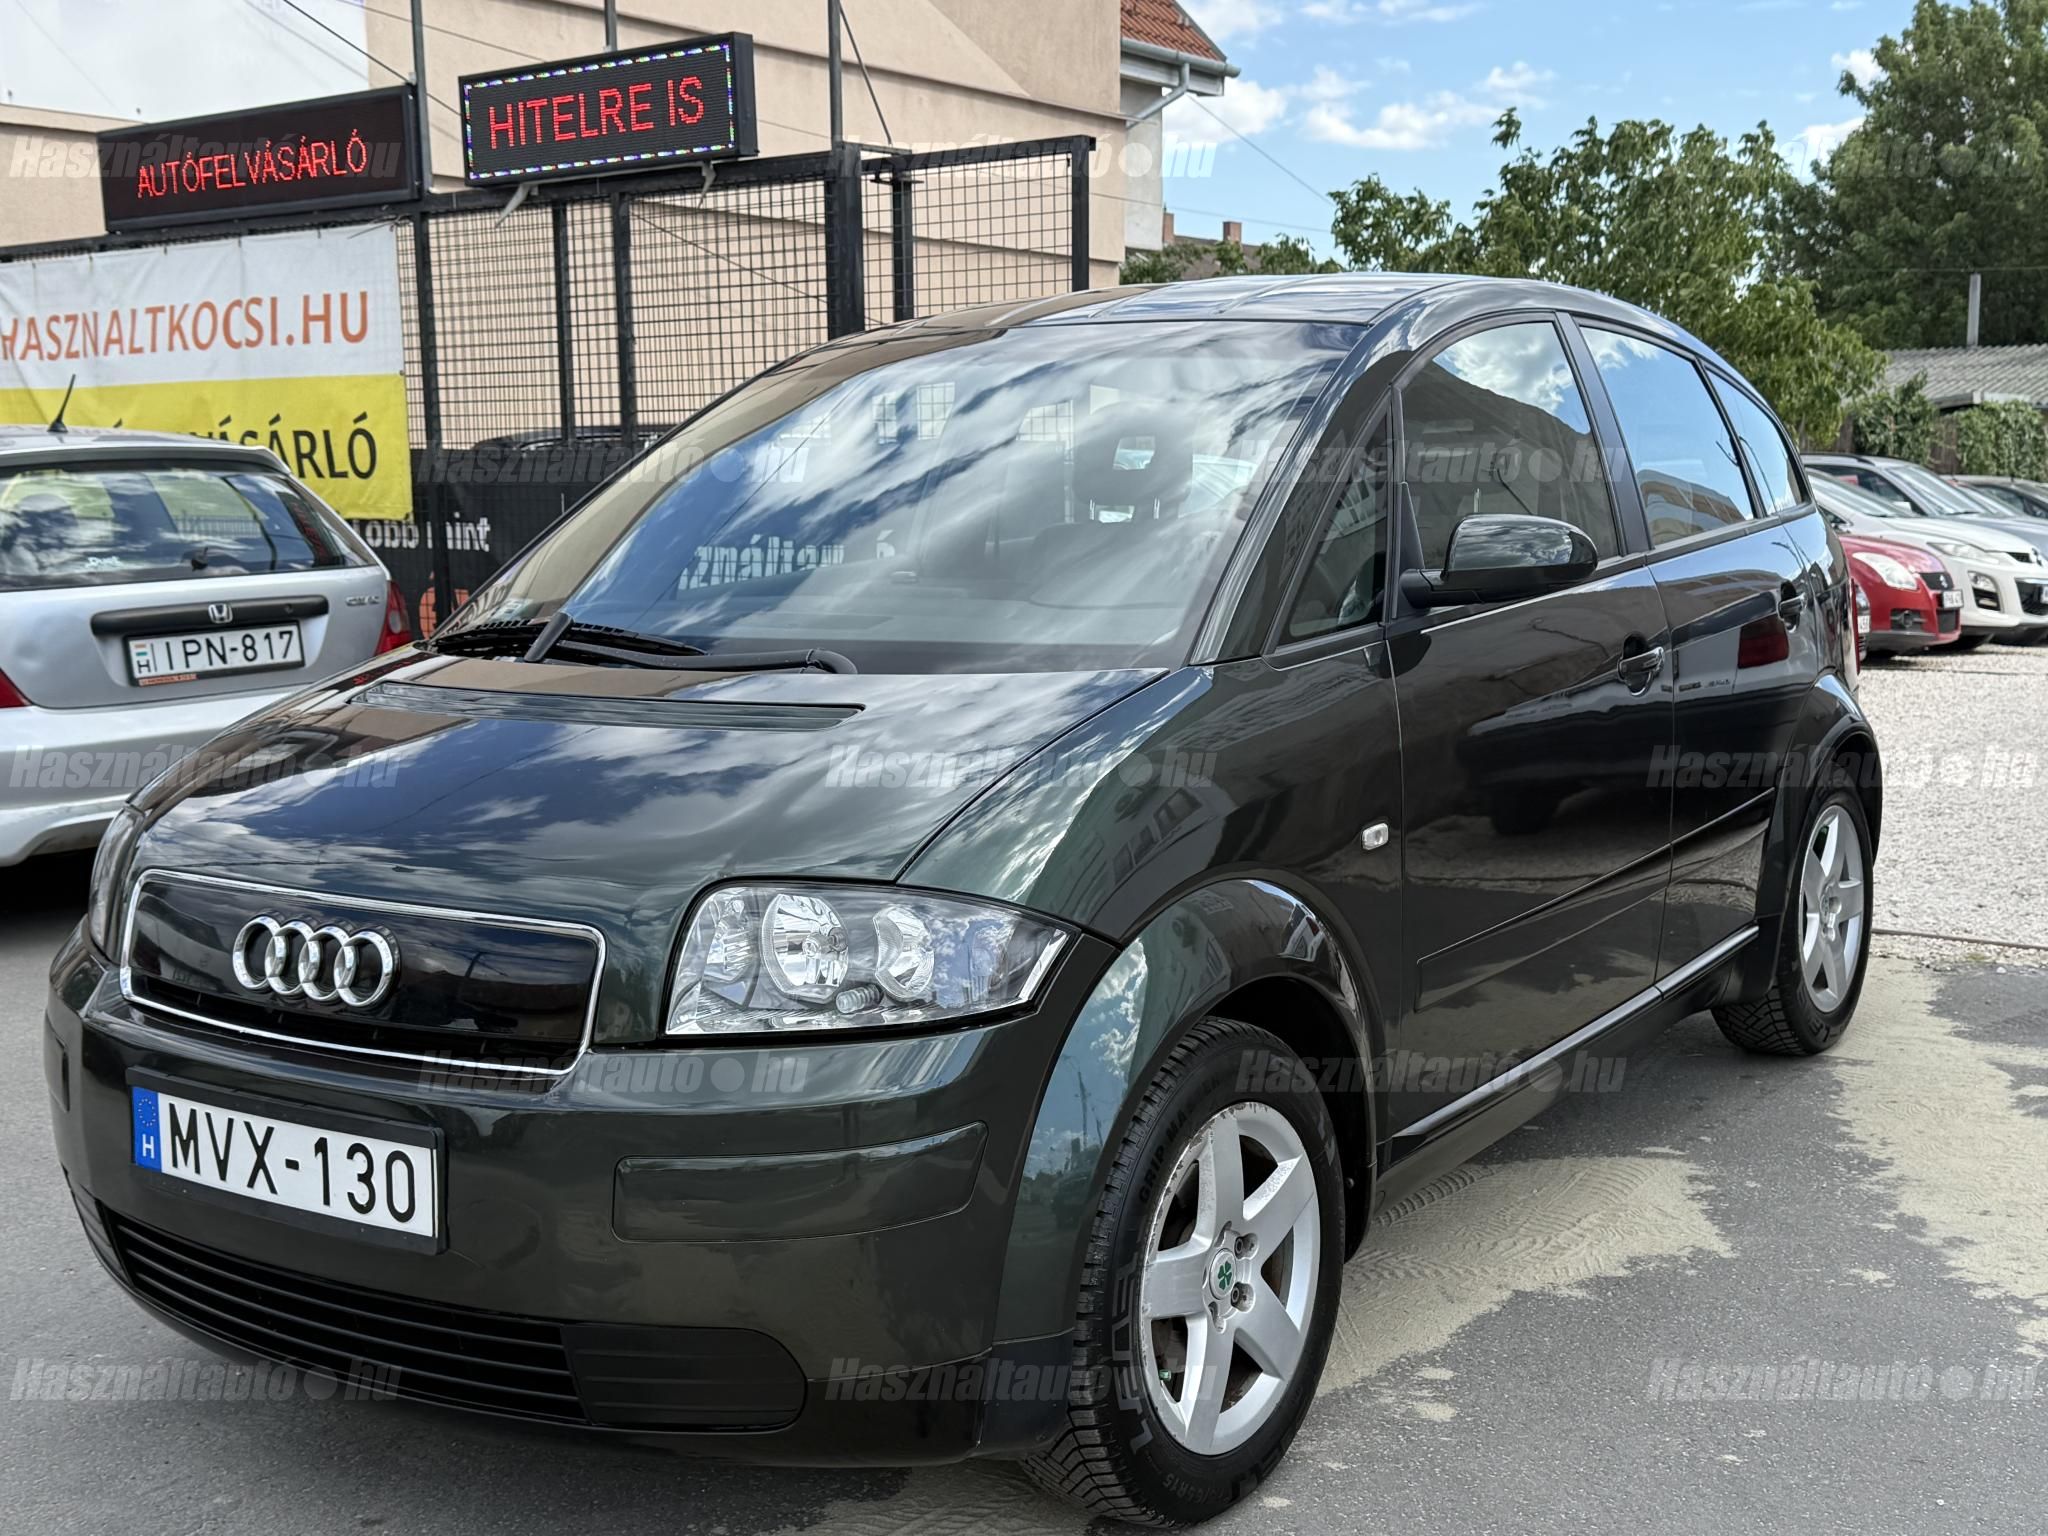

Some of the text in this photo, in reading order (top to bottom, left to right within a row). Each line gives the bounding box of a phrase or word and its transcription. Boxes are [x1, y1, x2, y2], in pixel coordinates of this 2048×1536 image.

[489, 75, 704, 149] HITELRE IS
[137, 128, 367, 199] AUTÓFELVÁSÁRLÓ
[0, 290, 368, 361] HASZNALTKOCSI.HU
[164, 630, 295, 672] IPN-817
[140, 1101, 418, 1224] H MVX-130
